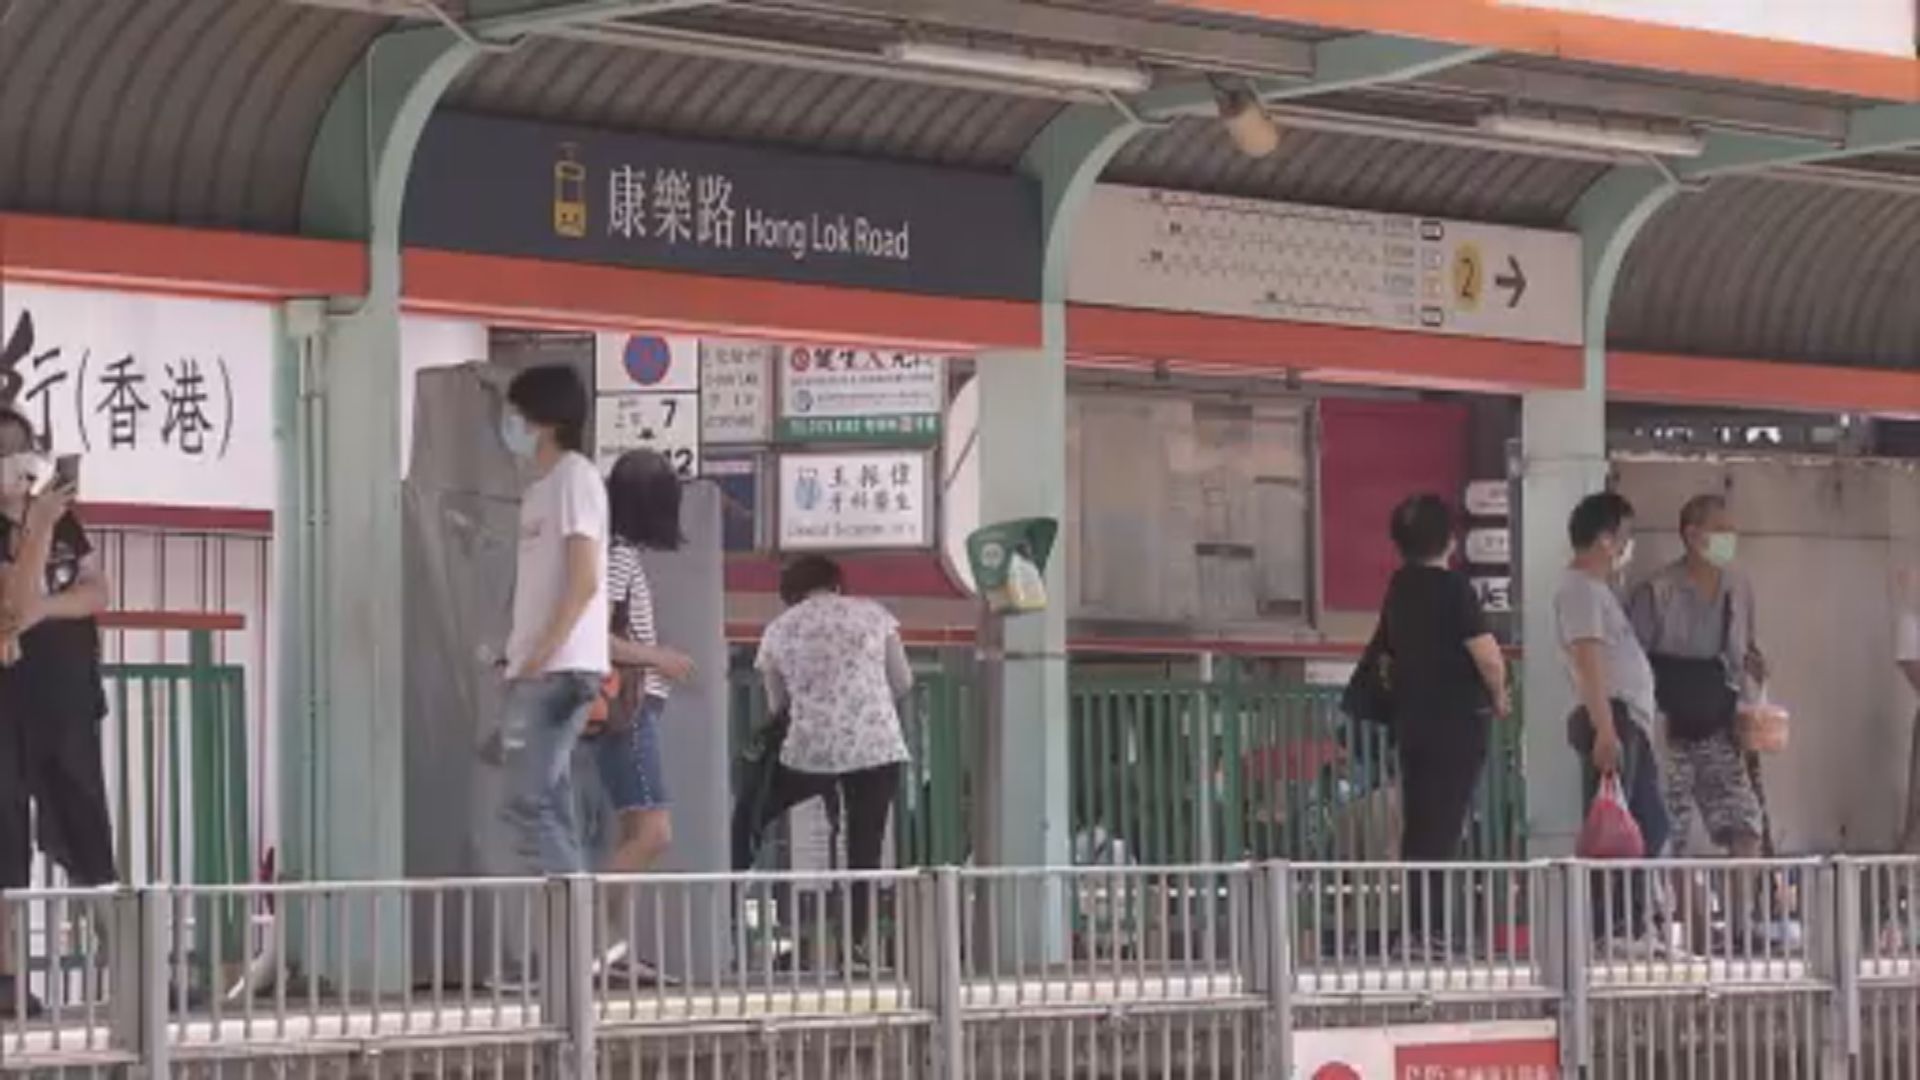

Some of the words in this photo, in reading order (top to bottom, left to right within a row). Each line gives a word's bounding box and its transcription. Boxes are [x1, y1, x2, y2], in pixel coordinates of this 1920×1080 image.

[607, 164, 736, 249] 康樂路
[743, 208, 808, 261] Hong
[811, 213, 851, 253] Lok
[854, 216, 911, 260] Road
[1459, 256, 1475, 300] 2
[660, 398, 678, 428] 7
